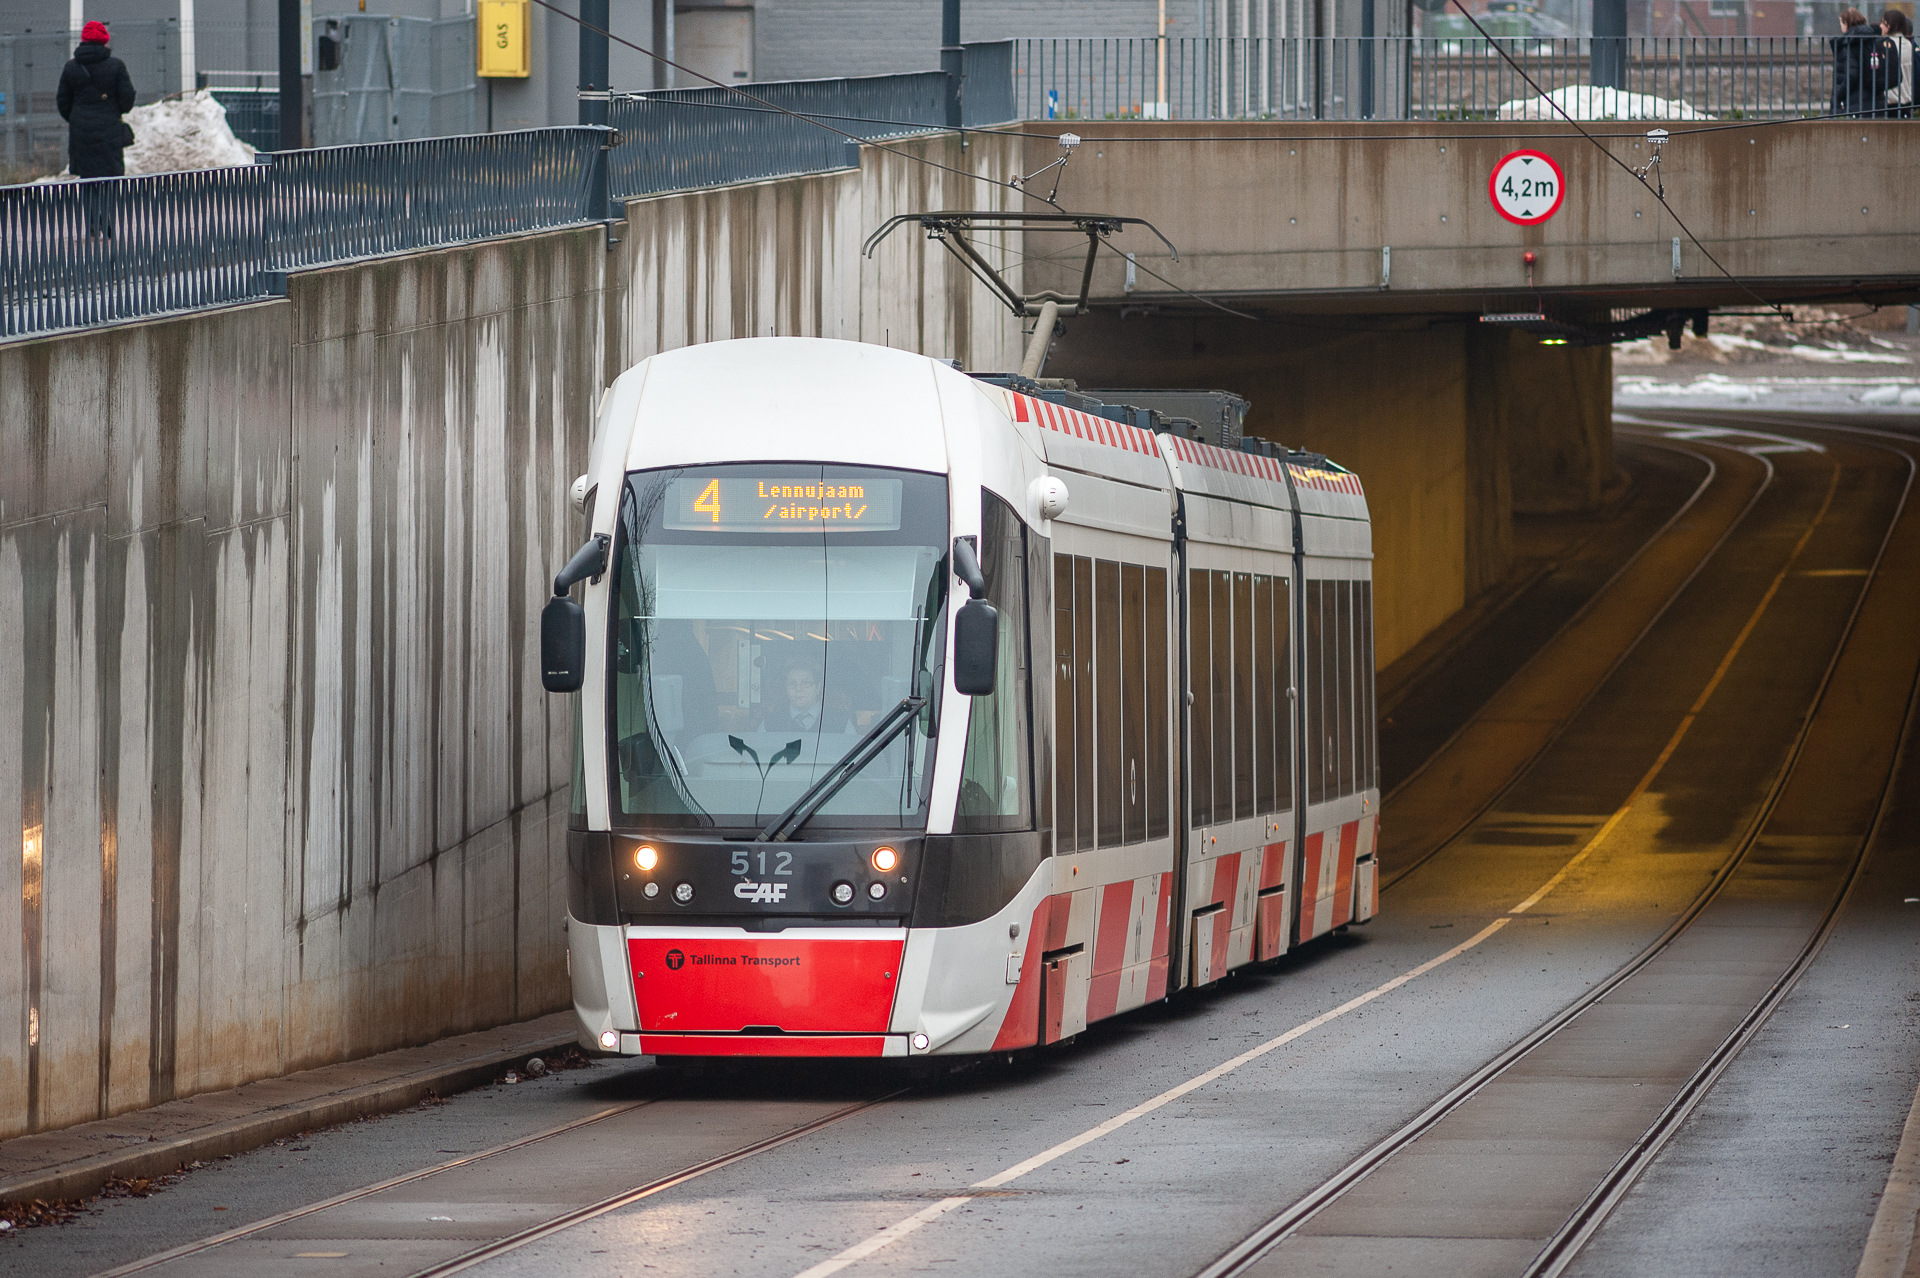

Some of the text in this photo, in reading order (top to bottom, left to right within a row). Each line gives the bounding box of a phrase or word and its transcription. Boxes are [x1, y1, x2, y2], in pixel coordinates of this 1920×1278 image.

[497, 23, 509, 49] GAS
[1501, 175, 1554, 201] 4,2m
[693, 478, 721, 522] 4
[758, 481, 865, 500] Lennujaam
[763, 502, 868, 521] /airport/
[731, 851, 793, 875] 512
[733, 882, 788, 903] CAF
[690, 954, 737, 965] Tallinna
[741, 955, 801, 968] Transport
